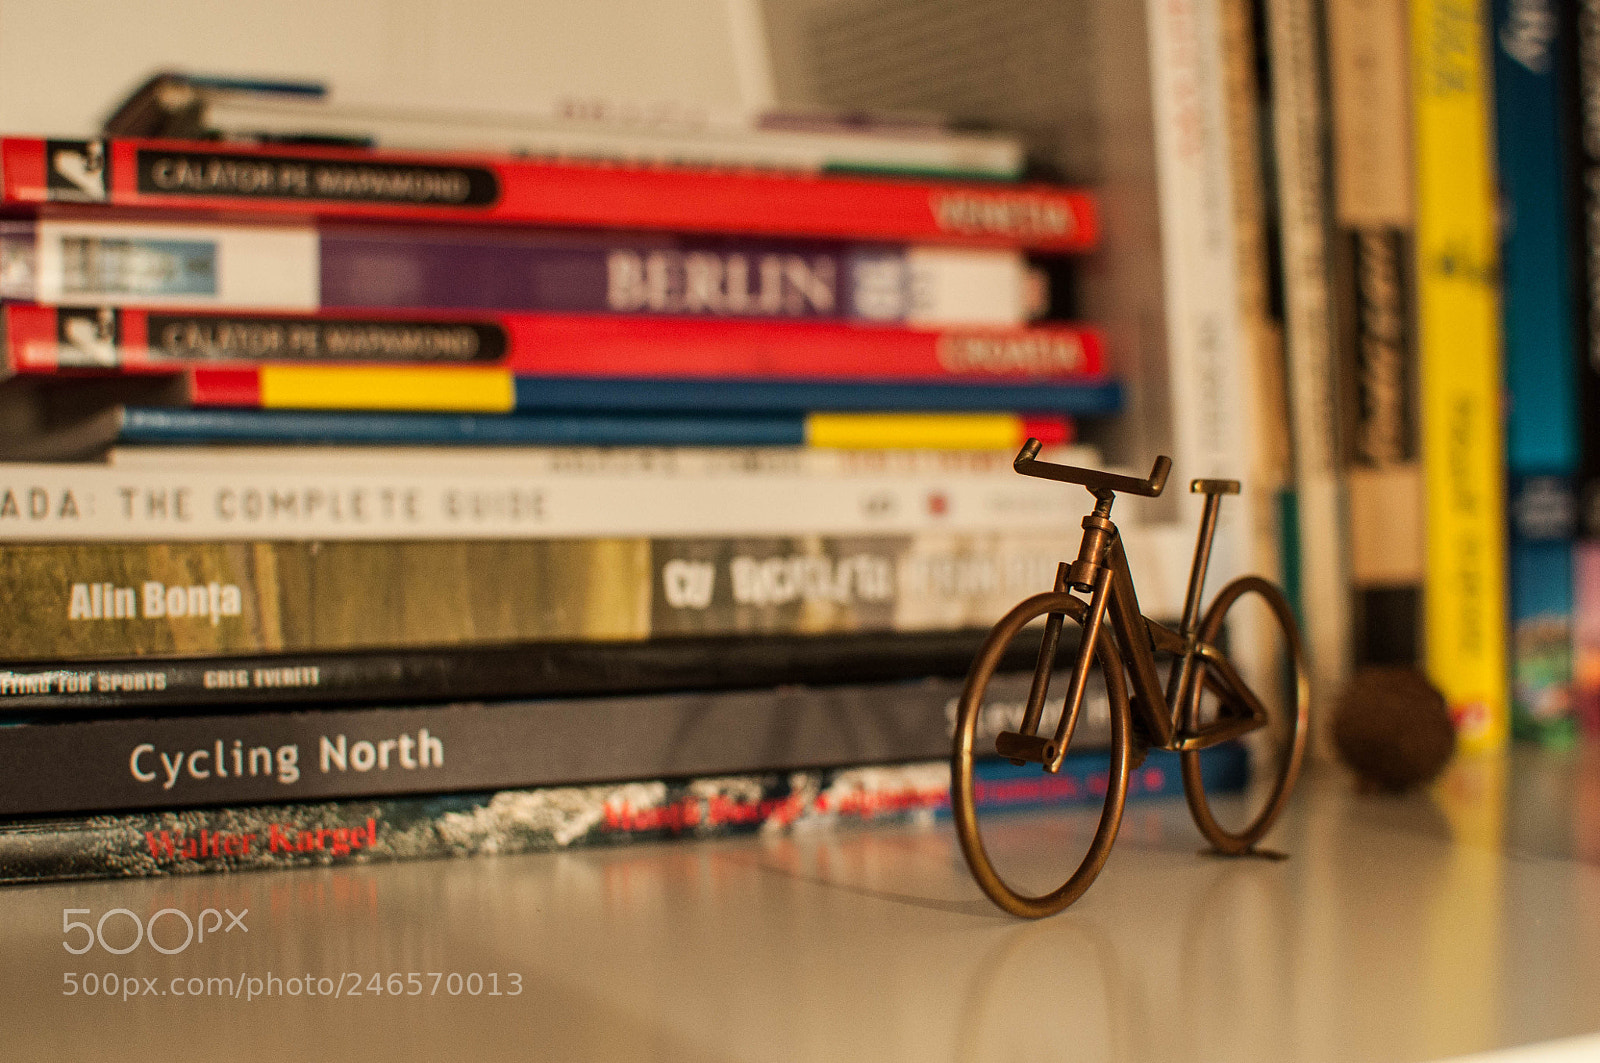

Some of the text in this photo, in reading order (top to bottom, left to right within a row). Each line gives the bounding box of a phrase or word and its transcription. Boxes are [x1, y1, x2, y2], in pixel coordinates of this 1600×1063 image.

[276, 164, 308, 194] PE
[607, 250, 837, 314] BERLIN
[286, 325, 320, 357] PE
[118, 486, 194, 521] THE
[215, 486, 420, 522] COMPLETE
[440, 486, 551, 522] GUIDE
[68, 582, 136, 620] Alin
[98, 671, 168, 692] SPORTS
[203, 669, 249, 689] GREG
[253, 665, 320, 688] EVERETT
[129, 728, 444, 789] Cycling North
[146, 817, 377, 860] Walter Kargel
